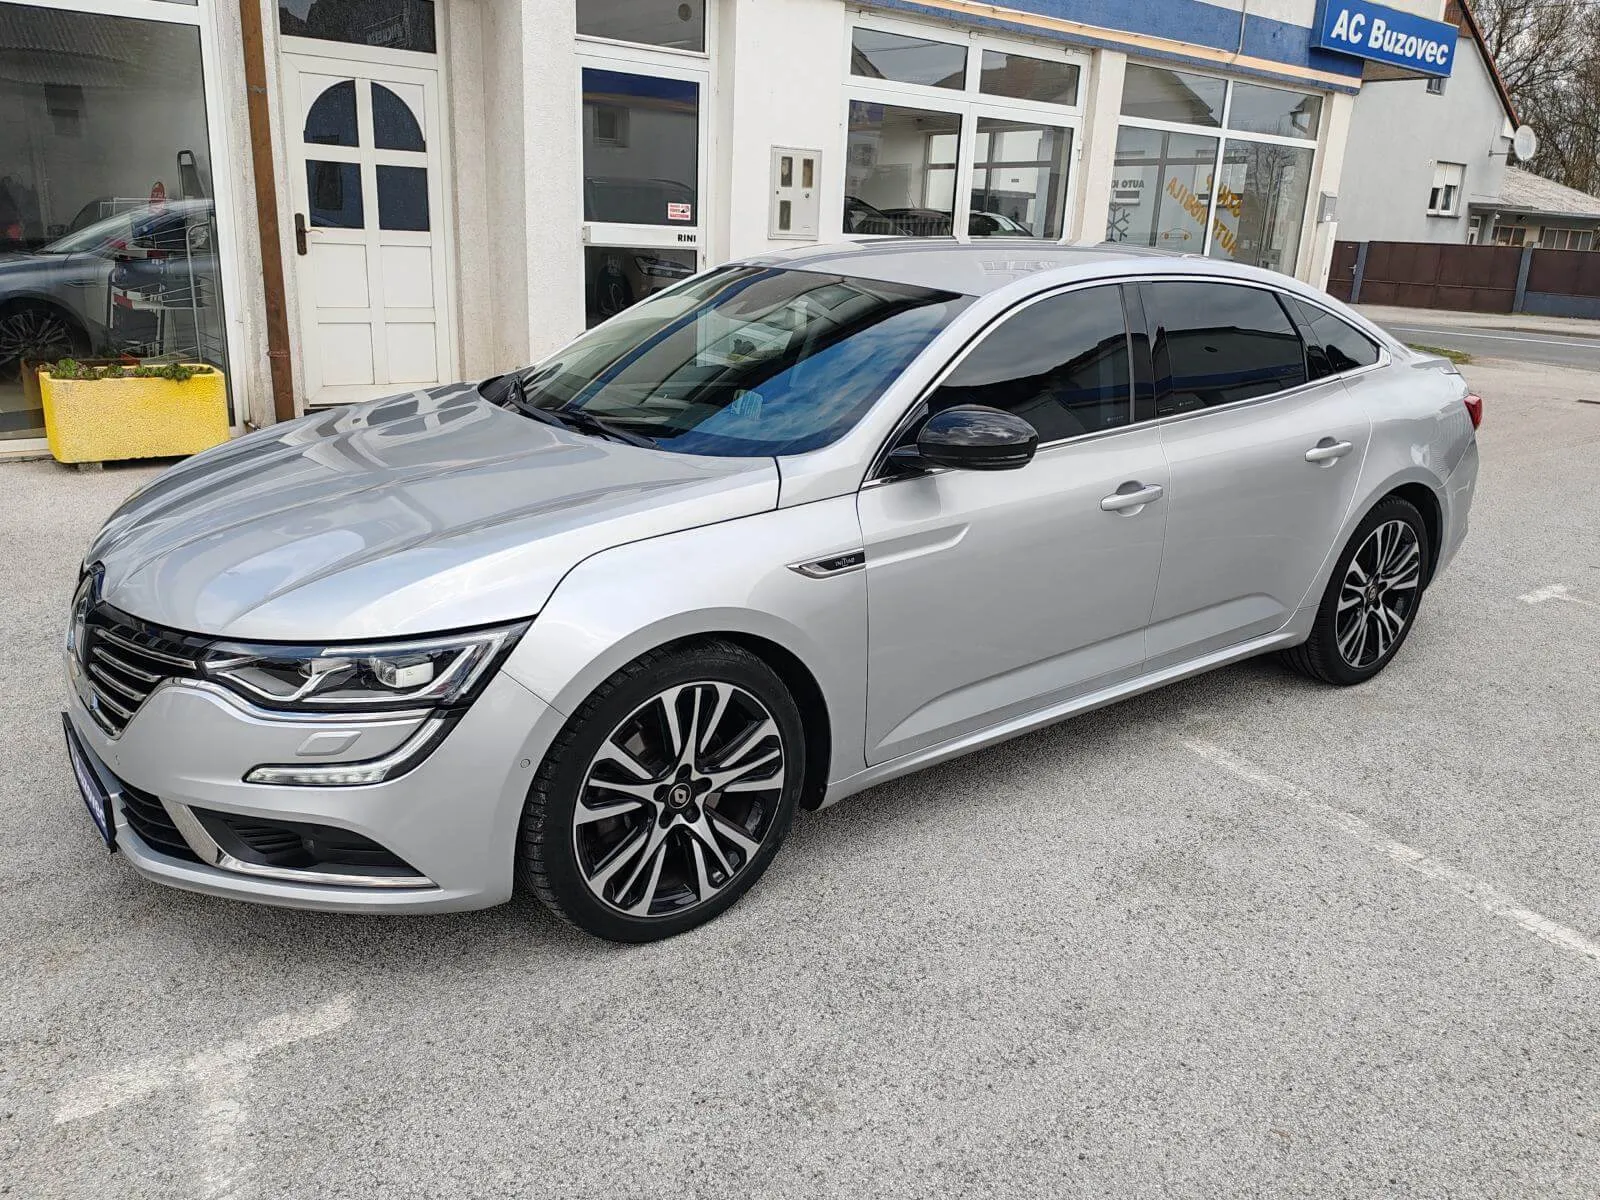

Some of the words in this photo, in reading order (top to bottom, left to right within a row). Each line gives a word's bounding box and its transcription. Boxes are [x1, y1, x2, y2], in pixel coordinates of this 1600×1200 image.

[1330, 9, 1366, 44] AC
[1368, 18, 1449, 66] Buzovec
[677, 234, 696, 242] RINI
